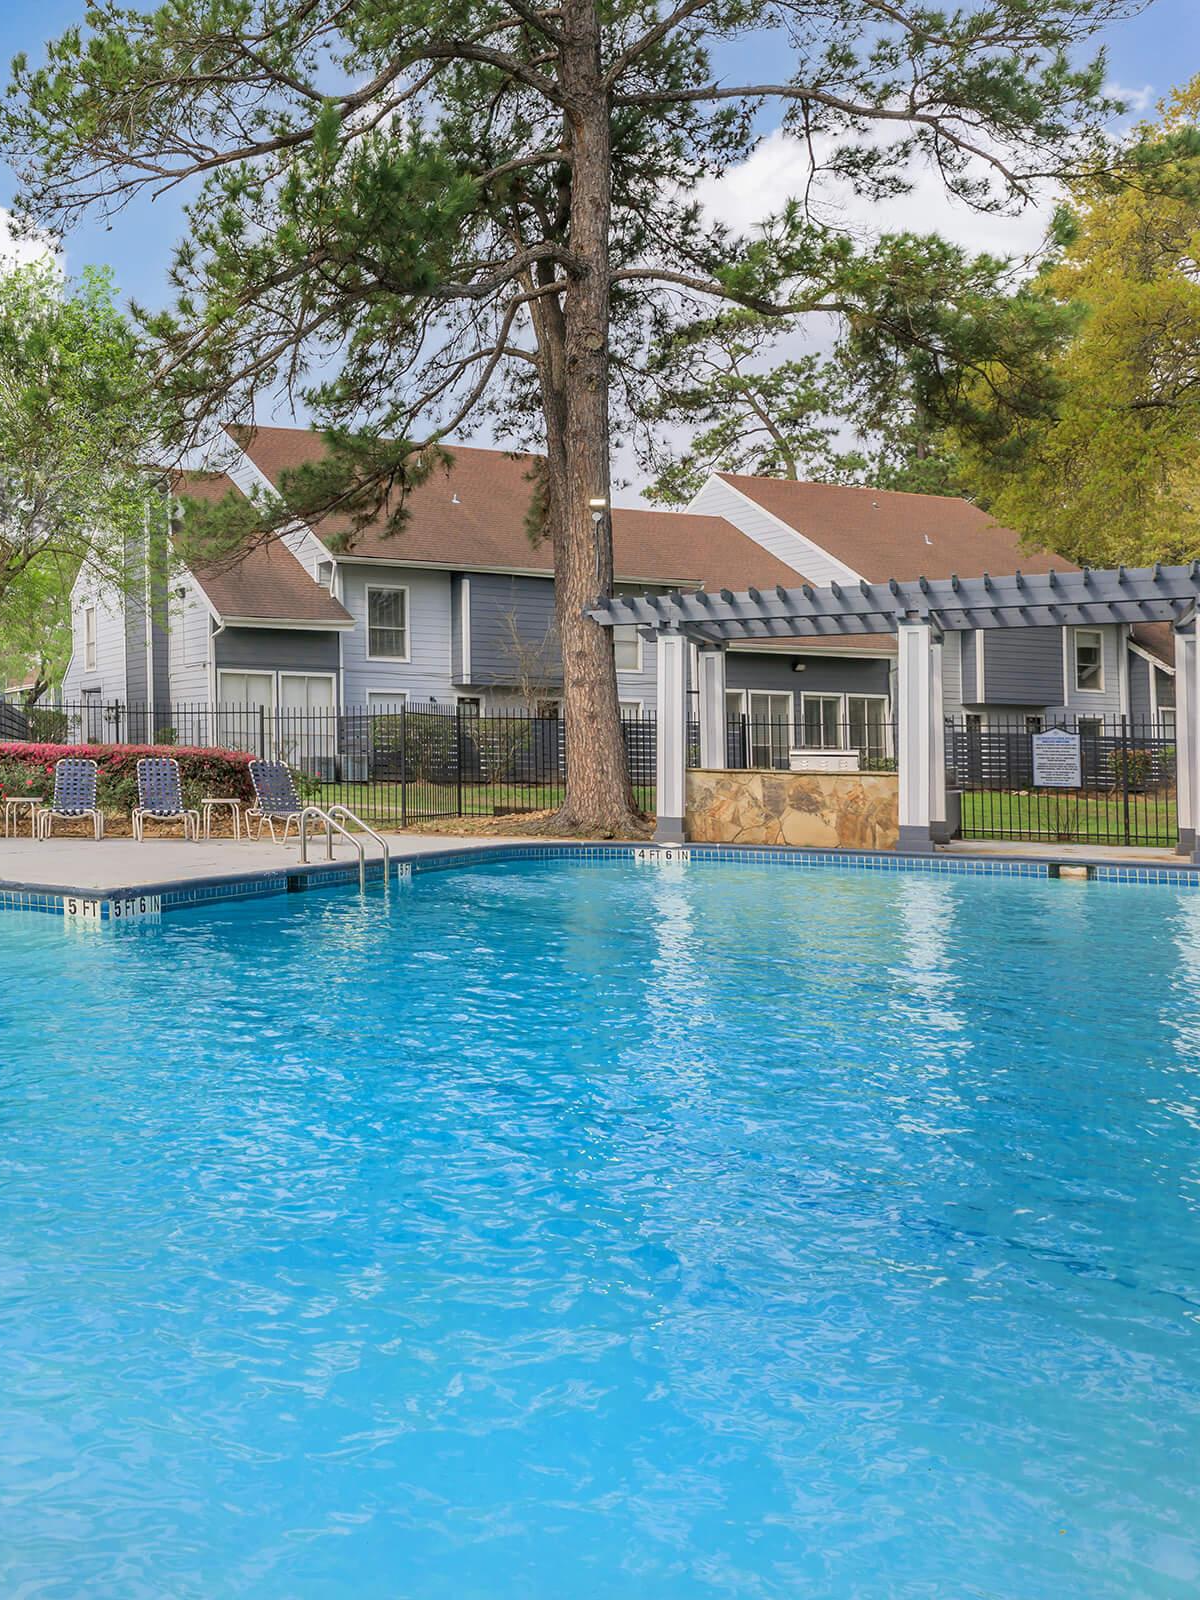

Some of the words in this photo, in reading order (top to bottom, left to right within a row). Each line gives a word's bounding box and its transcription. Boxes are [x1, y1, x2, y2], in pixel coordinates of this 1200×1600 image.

[638, 849, 645, 859] 4
[649, 850, 661, 859] FT
[665, 850, 672, 860] 6
[677, 850, 688, 860] IN
[68, 899, 77, 915] 5
[83, 900, 98, 917] FT
[114, 900, 121, 917] 5
[125, 899, 136, 917] FT
[140, 897, 146, 913] 6
[150, 895, 160, 912] IN
